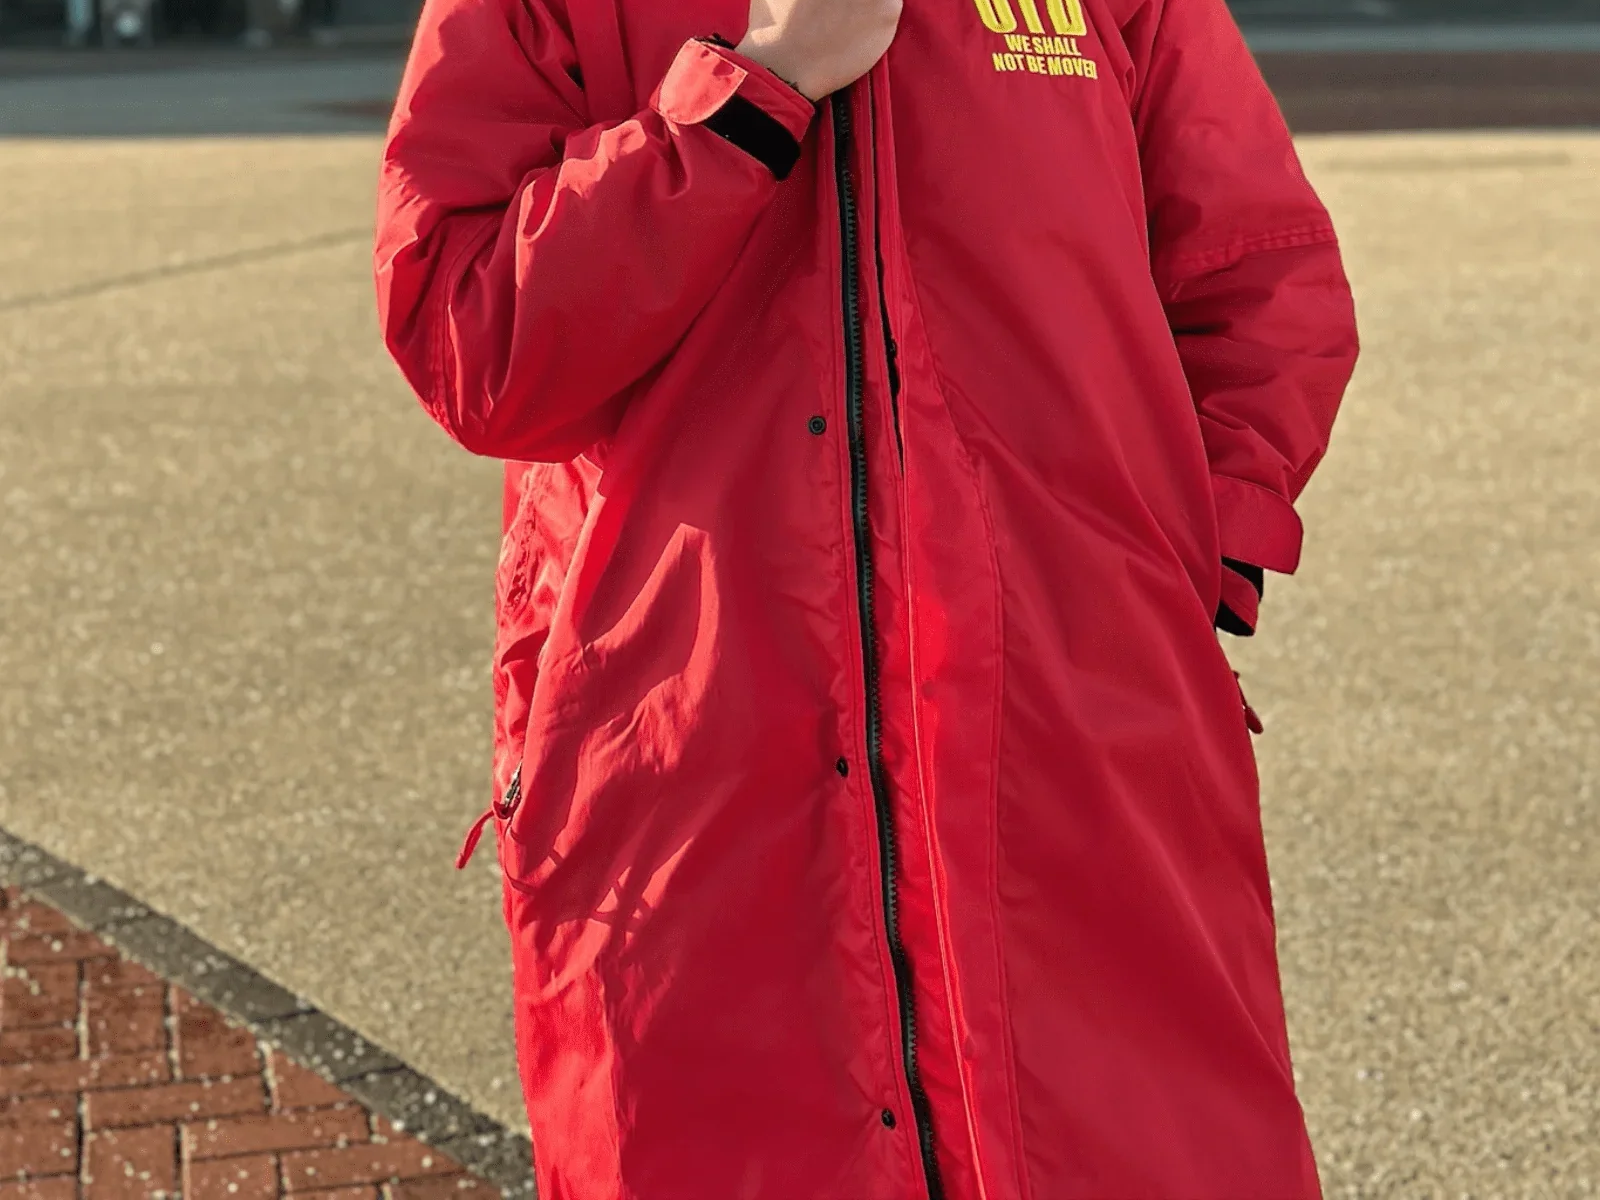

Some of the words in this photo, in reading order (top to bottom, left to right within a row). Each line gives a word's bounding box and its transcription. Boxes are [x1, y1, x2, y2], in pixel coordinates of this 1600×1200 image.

[1004, 34, 1032, 53] WE
[1032, 37, 1082, 56] SHALL
[992, 53, 1025, 71] NOT
[1026, 55, 1047, 74] BE
